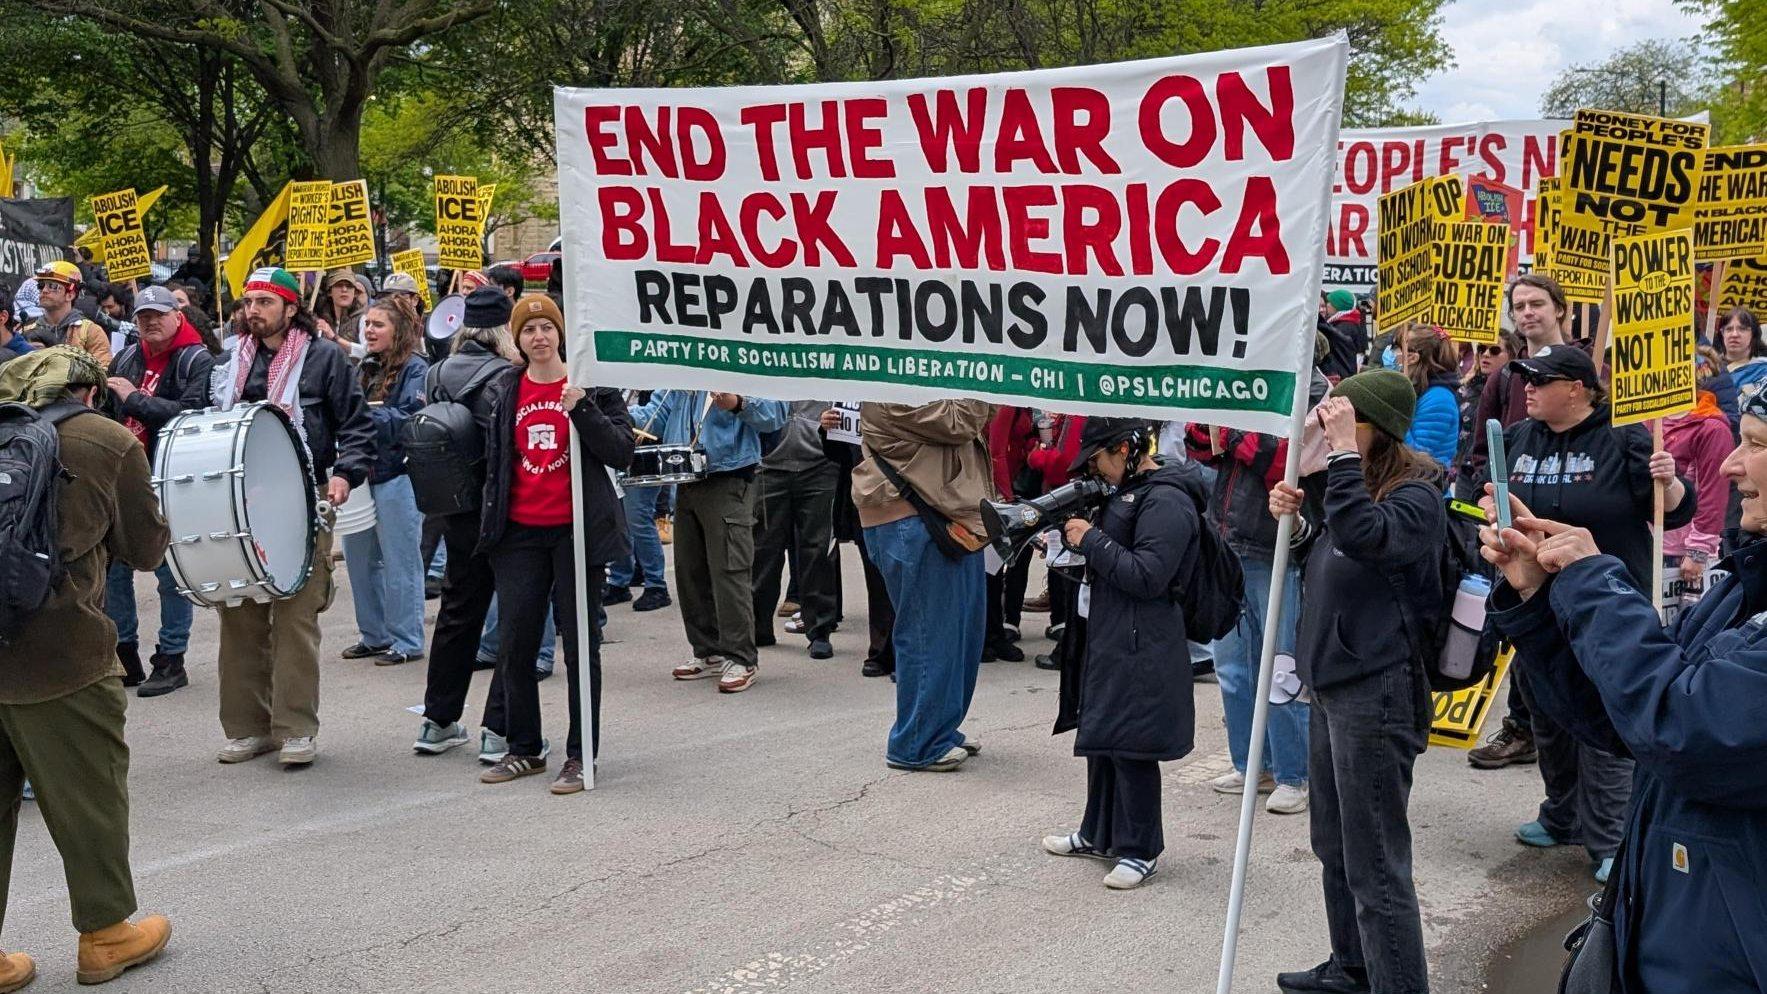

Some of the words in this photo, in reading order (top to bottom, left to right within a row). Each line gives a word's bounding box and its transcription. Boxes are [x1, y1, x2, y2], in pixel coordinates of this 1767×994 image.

[586, 106, 726, 181] END
[741, 99, 896, 181] THE
[907, 87, 1121, 174] WAR
[1138, 65, 1294, 168] ON
[1576, 122, 1703, 150] PEOPLE'S
[1578, 111, 1656, 130] MONEY
[1659, 120, 1705, 137] FOR
[1333, 133, 1507, 195] OPLE'S
[1570, 137, 1696, 205] NEEDS
[437, 179, 477, 197] ABOLISH
[1432, 178, 1462, 217] OP
[1697, 175, 1723, 202] HE
[94, 192, 136, 214] ABOLISH
[291, 204, 327, 225] RIGHTS!
[438, 197, 478, 222] ICE
[1380, 187, 1416, 233] MAY
[1484, 202, 1501, 213] ICE
[1575, 192, 1680, 227] NOT
[1694, 209, 1709, 218] N
[98, 209, 141, 236] ICE
[327, 223, 368, 237] HORA
[440, 224, 478, 236] AHORA
[598, 186, 857, 268] BLACK
[876, 176, 1291, 276] AMERICA
[1452, 223, 1483, 243] WAR
[1487, 225, 1507, 244] ON
[1600, 219, 1648, 237] THE
[1694, 217, 1766, 247] MERICA!
[105, 234, 144, 249] AHORA
[288, 229, 308, 247] STOP
[310, 230, 325, 246] THE
[440, 236, 479, 248] AHORA
[1380, 231, 1397, 263] NO
[1401, 214, 1434, 254] WORK
[1560, 225, 1600, 254] WAR
[0, 238, 19, 274] ST
[107, 245, 146, 260] AHORA
[109, 256, 148, 271] AHORA
[440, 248, 479, 260] AHORA
[1558, 253, 1579, 266] PARTY
[1580, 257, 1593, 268] FOR
[1614, 235, 1690, 286] POWER
[1322, 267, 1378, 282] ERATI
[1380, 265, 1394, 292] NO
[1397, 247, 1432, 285] SCHOOL
[1645, 278, 1653, 290] TO
[1654, 273, 1666, 288] THE
[1380, 295, 1391, 315] NO
[1394, 273, 1433, 308] SHOPPING
[1434, 281, 1458, 305] ND
[1466, 283, 1499, 308] THE
[1615, 284, 1691, 325] WORKERS
[1719, 297, 1767, 309] AHO
[634, 270, 1048, 350] REPARATIONS
[1063, 286, 1250, 358] NOW!
[1615, 331, 1654, 374] NOT
[1662, 325, 1691, 366] THE
[630, 339, 692, 358] PARTY
[697, 342, 730, 362] FOR
[738, 348, 835, 370] SOCIALISM
[843, 354, 880, 371] AND
[888, 357, 1003, 383] LIBERATION
[1030, 369, 1065, 390] CHI
[1099, 375, 1268, 400] @PSLCHICAGO
[1615, 364, 1691, 400] BILLIONAIRES!
[527, 424, 558, 450] PSL
[1548, 474, 1572, 484] LOAL
